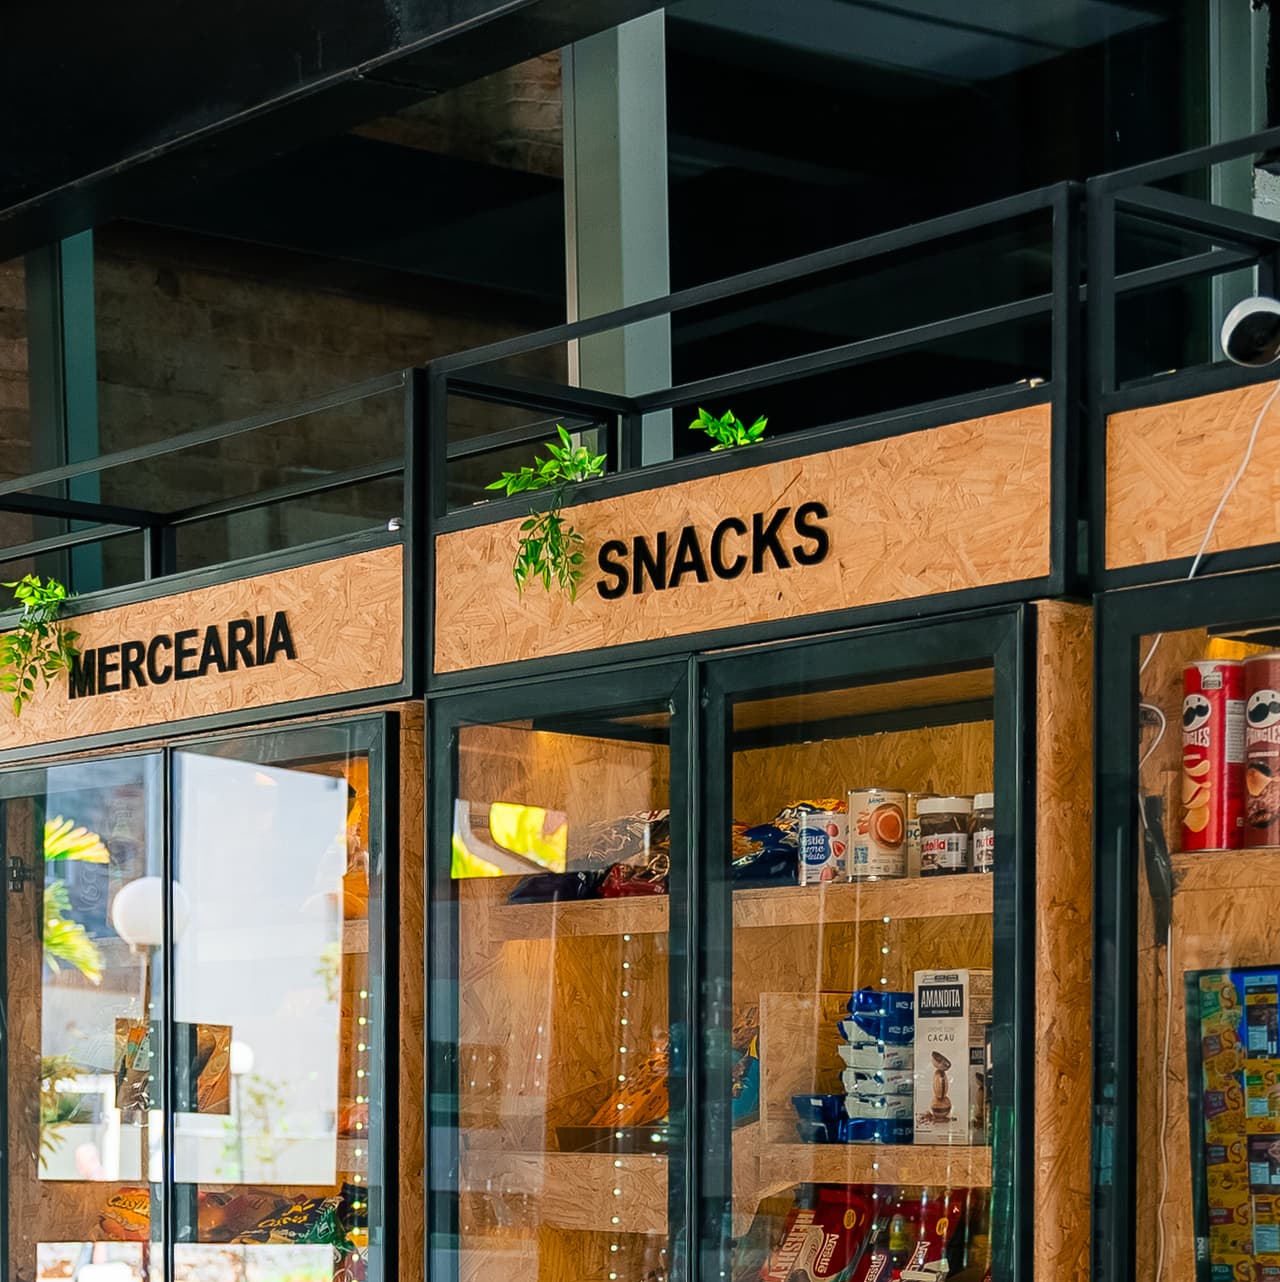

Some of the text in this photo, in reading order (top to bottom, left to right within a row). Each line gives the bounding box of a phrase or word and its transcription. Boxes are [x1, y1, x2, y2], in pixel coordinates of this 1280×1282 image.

[596, 501, 830, 600] SNACKS
[68, 610, 297, 700] MERCEARIA
[975, 836, 994, 850] nute
[920, 988, 962, 1010] AMANDITA
[927, 1032, 955, 1043] CACAU
